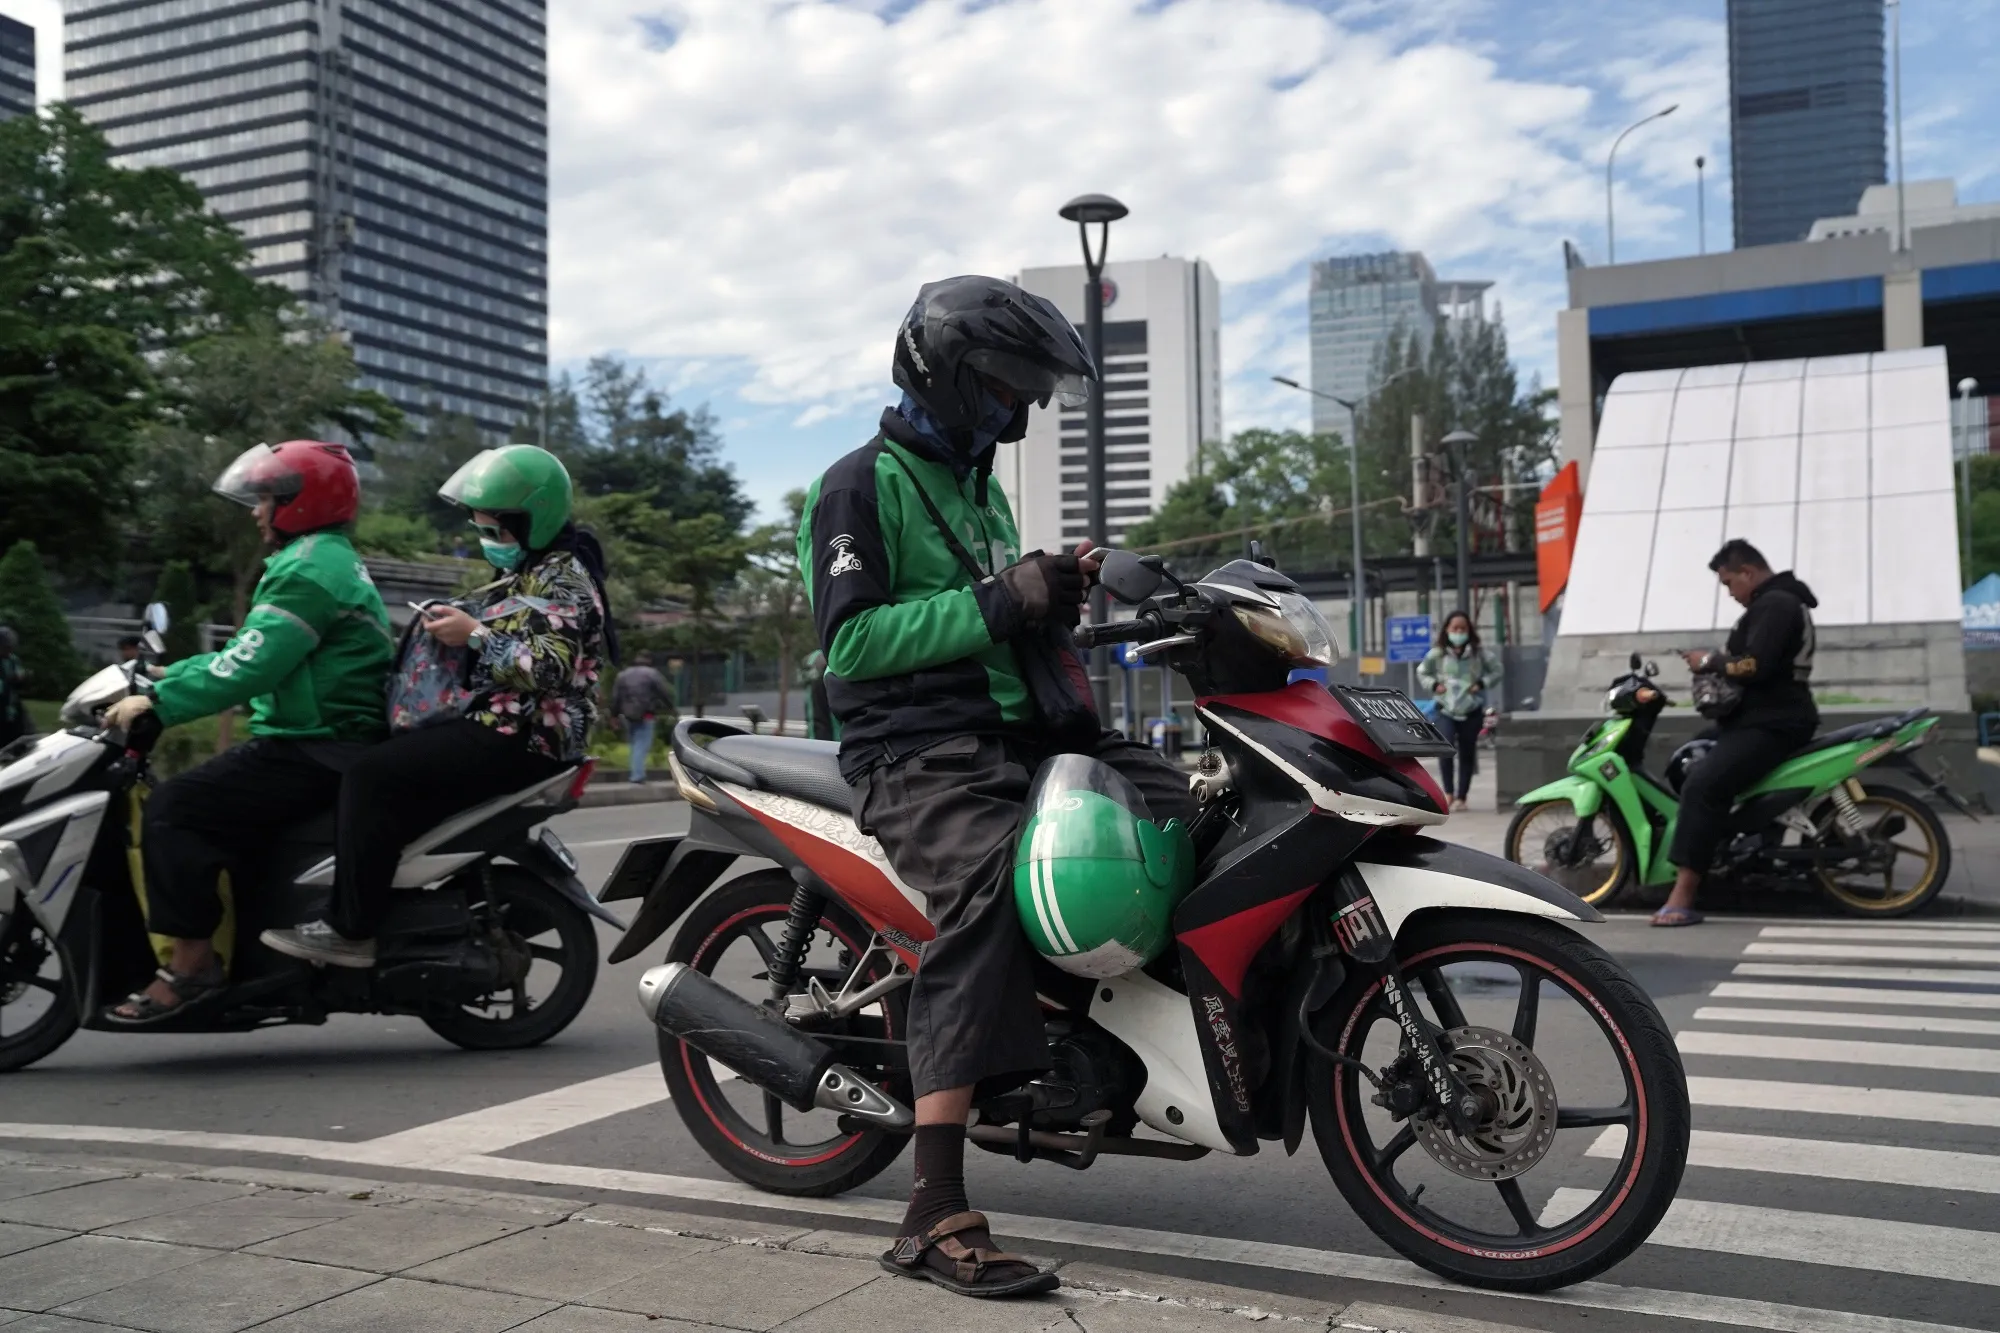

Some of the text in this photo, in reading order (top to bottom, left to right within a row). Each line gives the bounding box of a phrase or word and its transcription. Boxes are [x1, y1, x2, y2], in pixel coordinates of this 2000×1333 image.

[208, 629, 265, 677] Grab
[1348, 697, 1370, 718] B
[1332, 902, 1385, 953] FIAT
[1587, 994, 1632, 1058] HONDA
[743, 1143, 786, 1165] HONDA
[1471, 1248, 1540, 1260] HONDA
